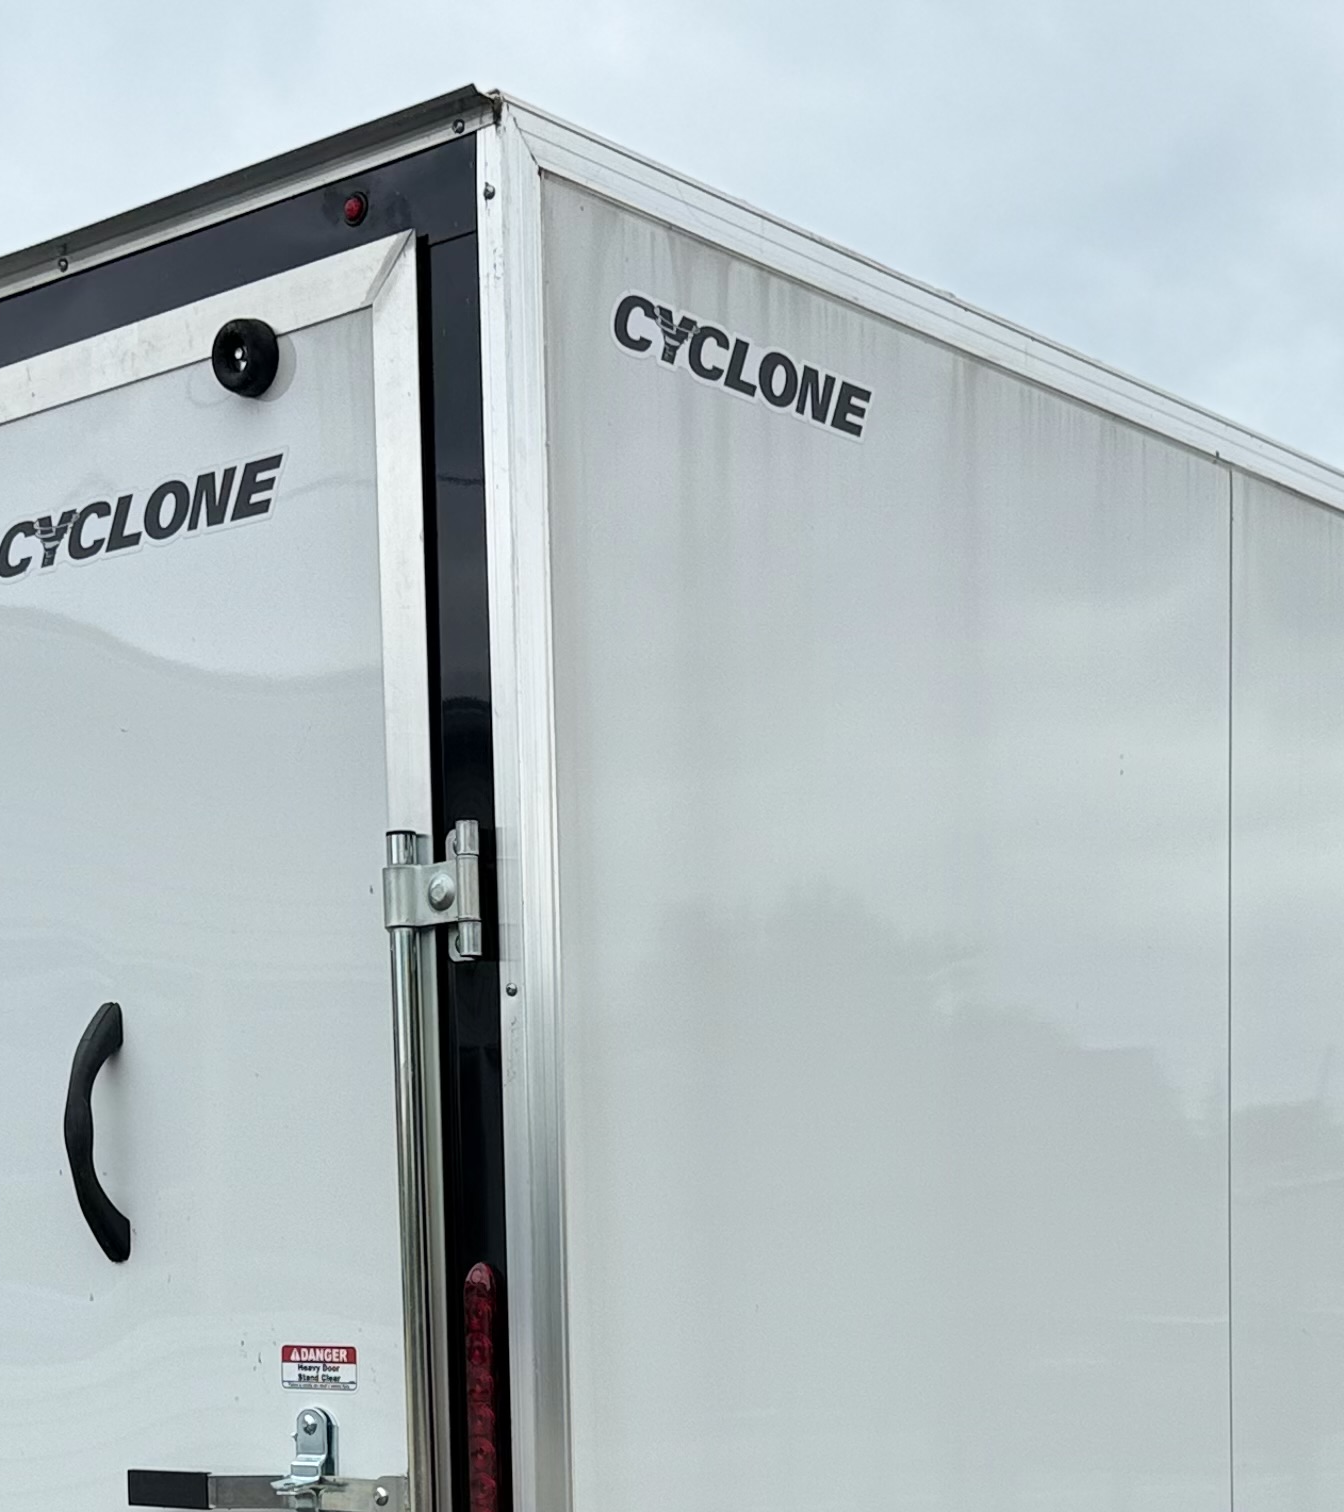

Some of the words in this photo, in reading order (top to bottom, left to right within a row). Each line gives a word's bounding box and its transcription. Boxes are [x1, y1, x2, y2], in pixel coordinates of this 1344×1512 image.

[614, 295, 872, 437] CYCLONE
[301, 1348, 348, 1362] DANGER
[298, 1364, 320, 1373] Heavy
[323, 1364, 340, 1372] Door
[321, 1374, 341, 1382] Clear
